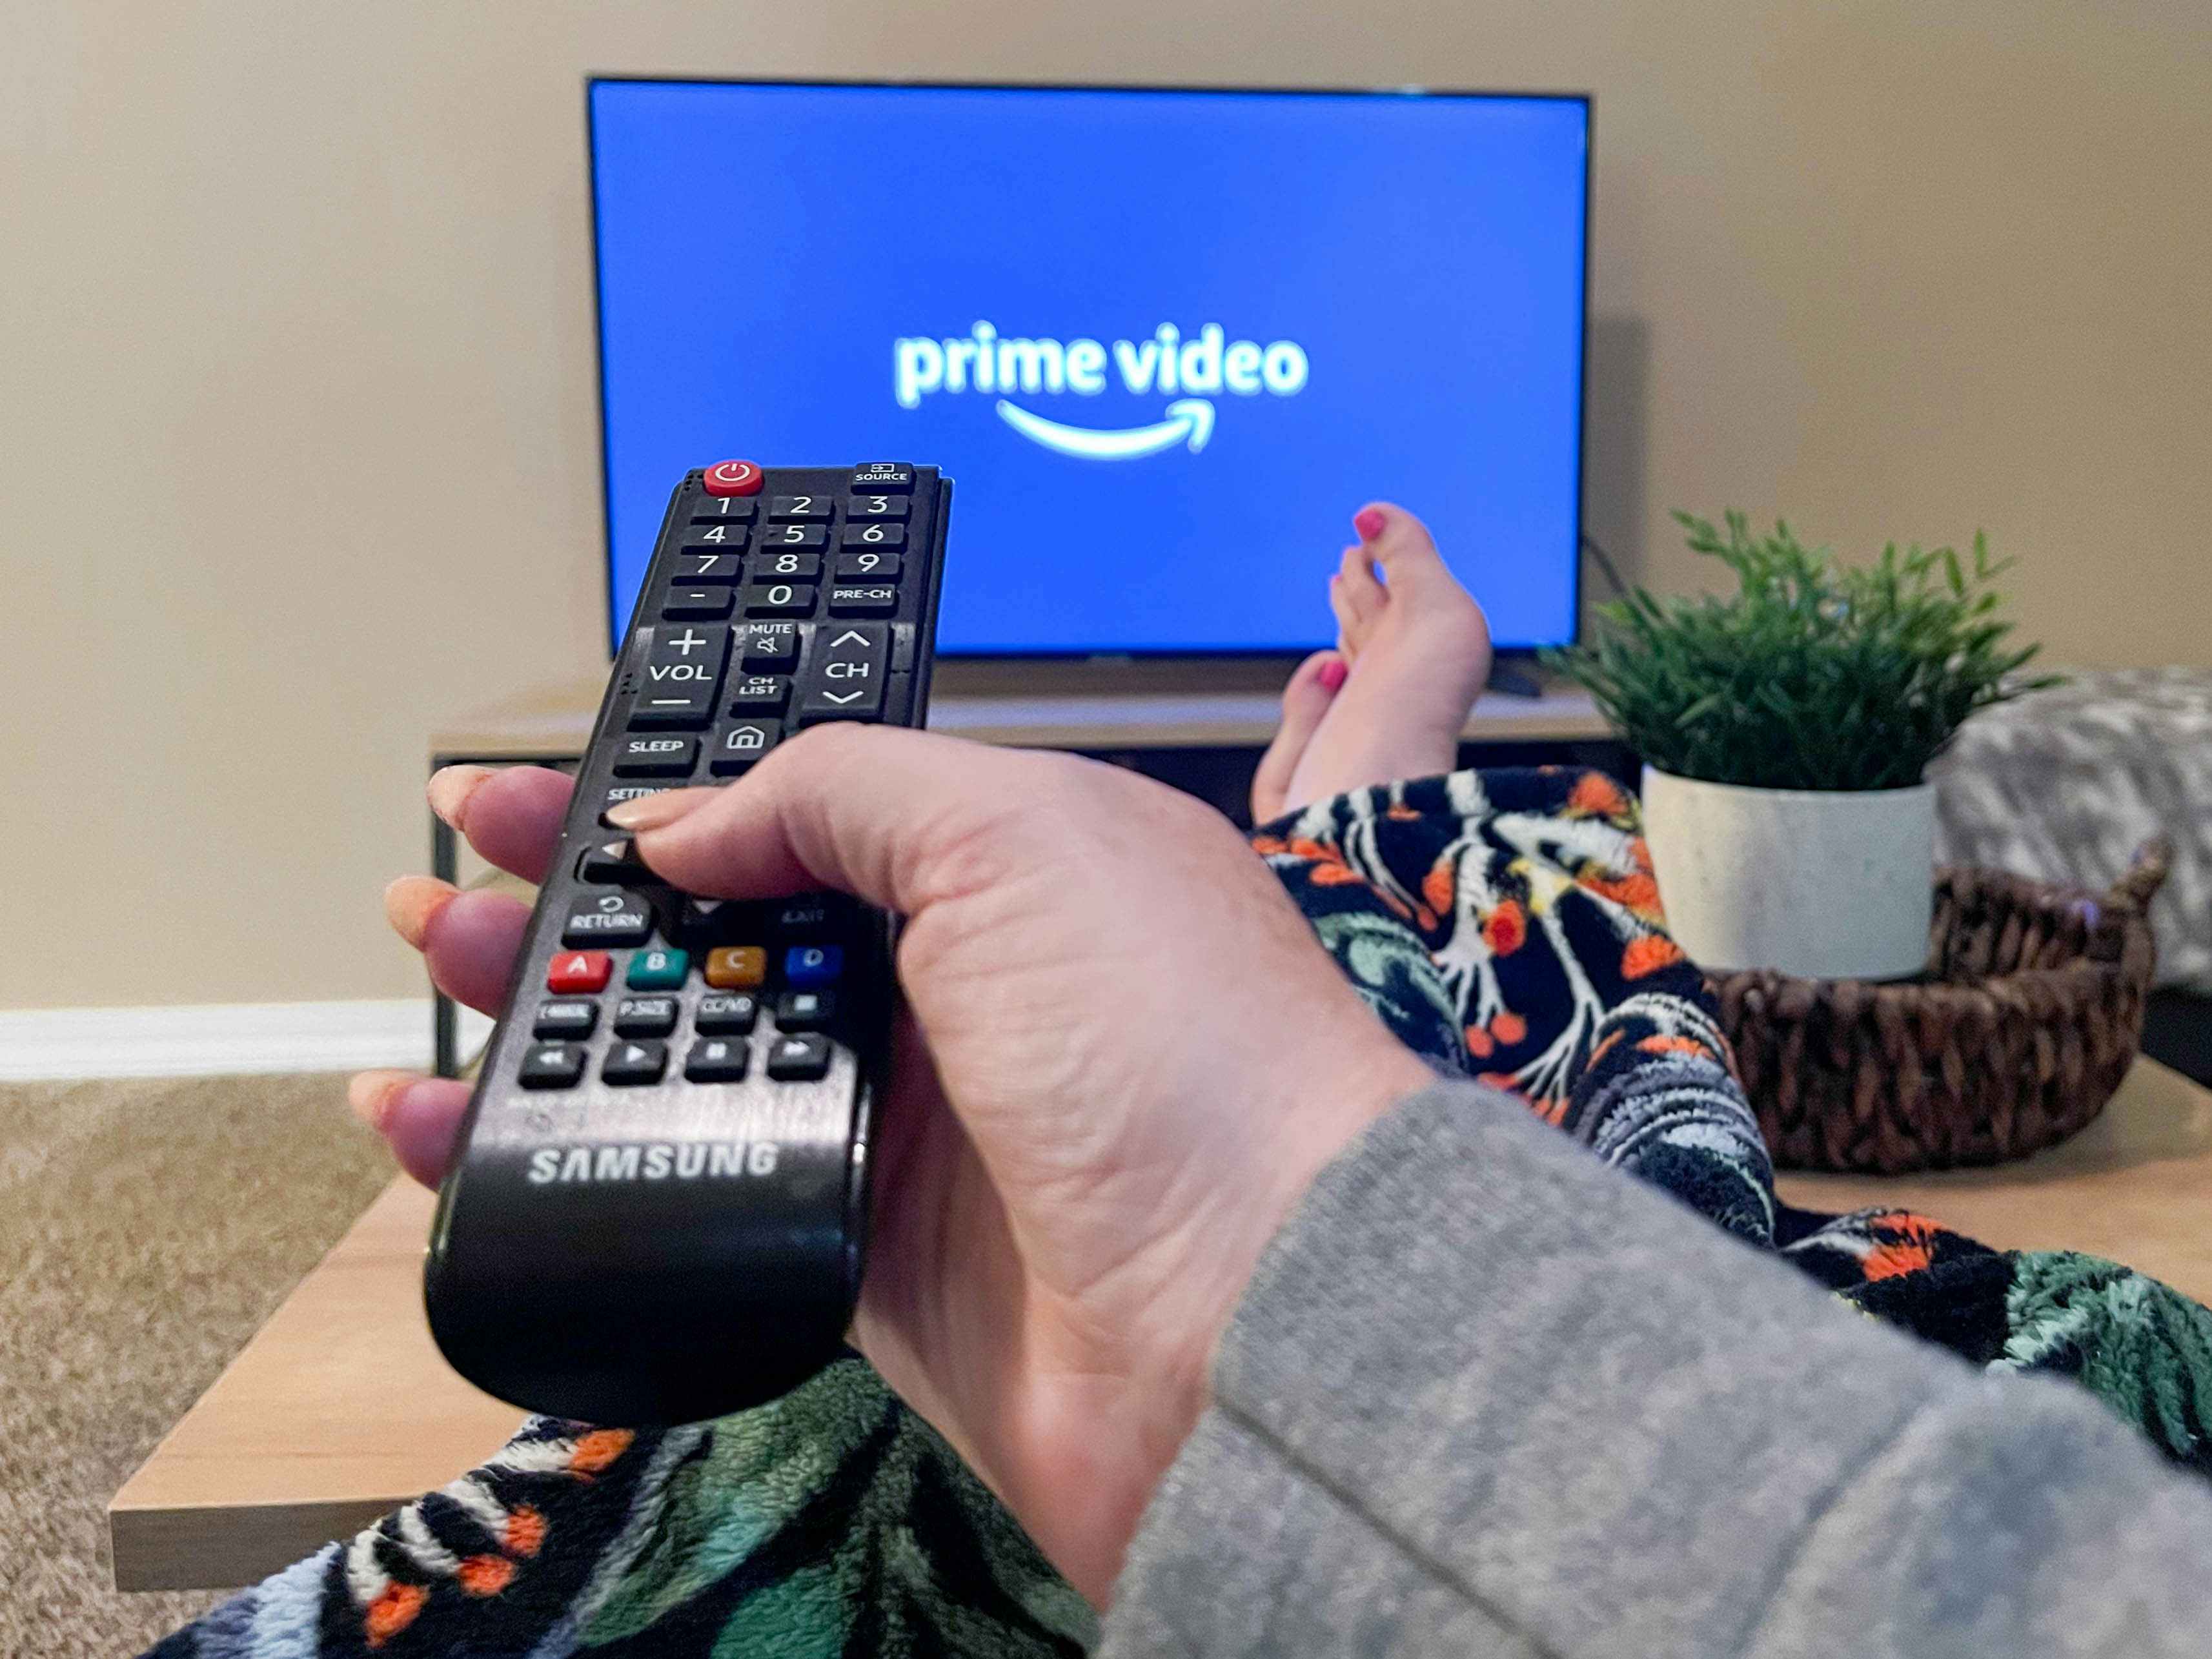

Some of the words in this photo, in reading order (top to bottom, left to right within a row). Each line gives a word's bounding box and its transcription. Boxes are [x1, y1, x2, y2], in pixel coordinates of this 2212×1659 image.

[895, 321, 1107, 408] prime
[1113, 323, 1308, 394] video
[855, 471, 907, 481] SOURCE
[717, 497, 731, 514] 1
[790, 496, 811, 514] 2
[867, 496, 888, 513] 3
[703, 525, 725, 544] 4
[784, 525, 805, 543] 5
[862, 524, 884, 542] 6
[697, 555, 719, 574] 7
[775, 554, 798, 573] 8
[858, 554, 880, 572] 9
[768, 585, 792, 605] 0
[833, 589, 892, 599] PRE-CH
[748, 624, 793, 634] MUTE
[649, 665, 712, 681] VOL
[825, 662, 869, 678] CH
[738, 686, 778, 695] LIST
[629, 740, 684, 753] SLEEP
[570, 913, 643, 929] RETURN
[567, 955, 587, 973] A
[647, 952, 666, 970] B
[727, 951, 744, 969] C
[804, 949, 824, 967] D
[527, 1140, 779, 1184] SAMSUNG
